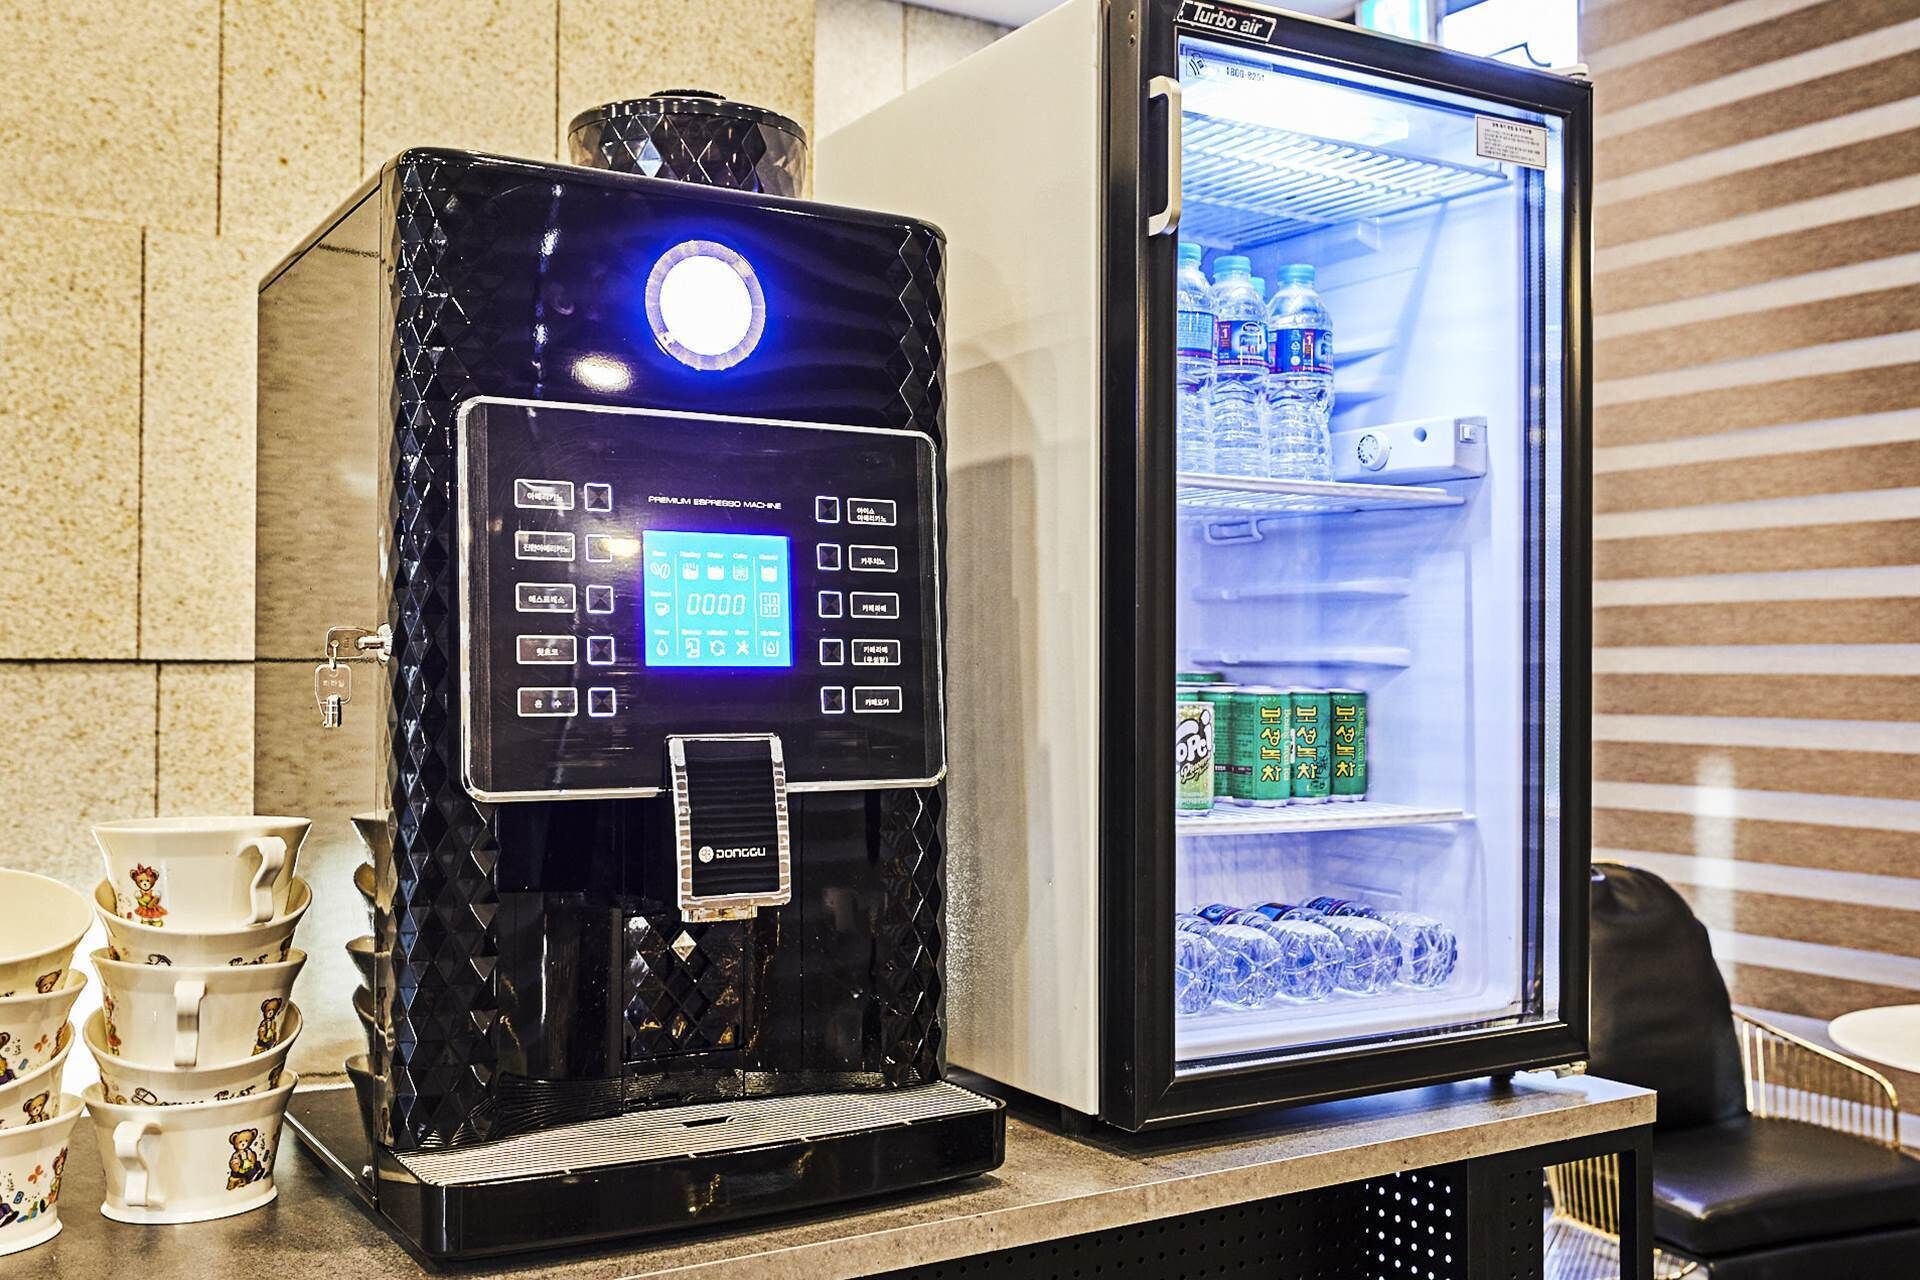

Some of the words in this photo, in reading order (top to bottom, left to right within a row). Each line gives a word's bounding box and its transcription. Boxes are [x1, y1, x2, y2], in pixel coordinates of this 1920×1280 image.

[1193, 1, 1237, 29] Turbo
[1240, 19, 1263, 34] air
[648, 495, 691, 505] PREMIUM
[693, 498, 741, 508] ESPRESSO
[743, 501, 782, 510] MACHINE
[686, 593, 746, 615] 0000
[716, 847, 766, 859] DONGGU
